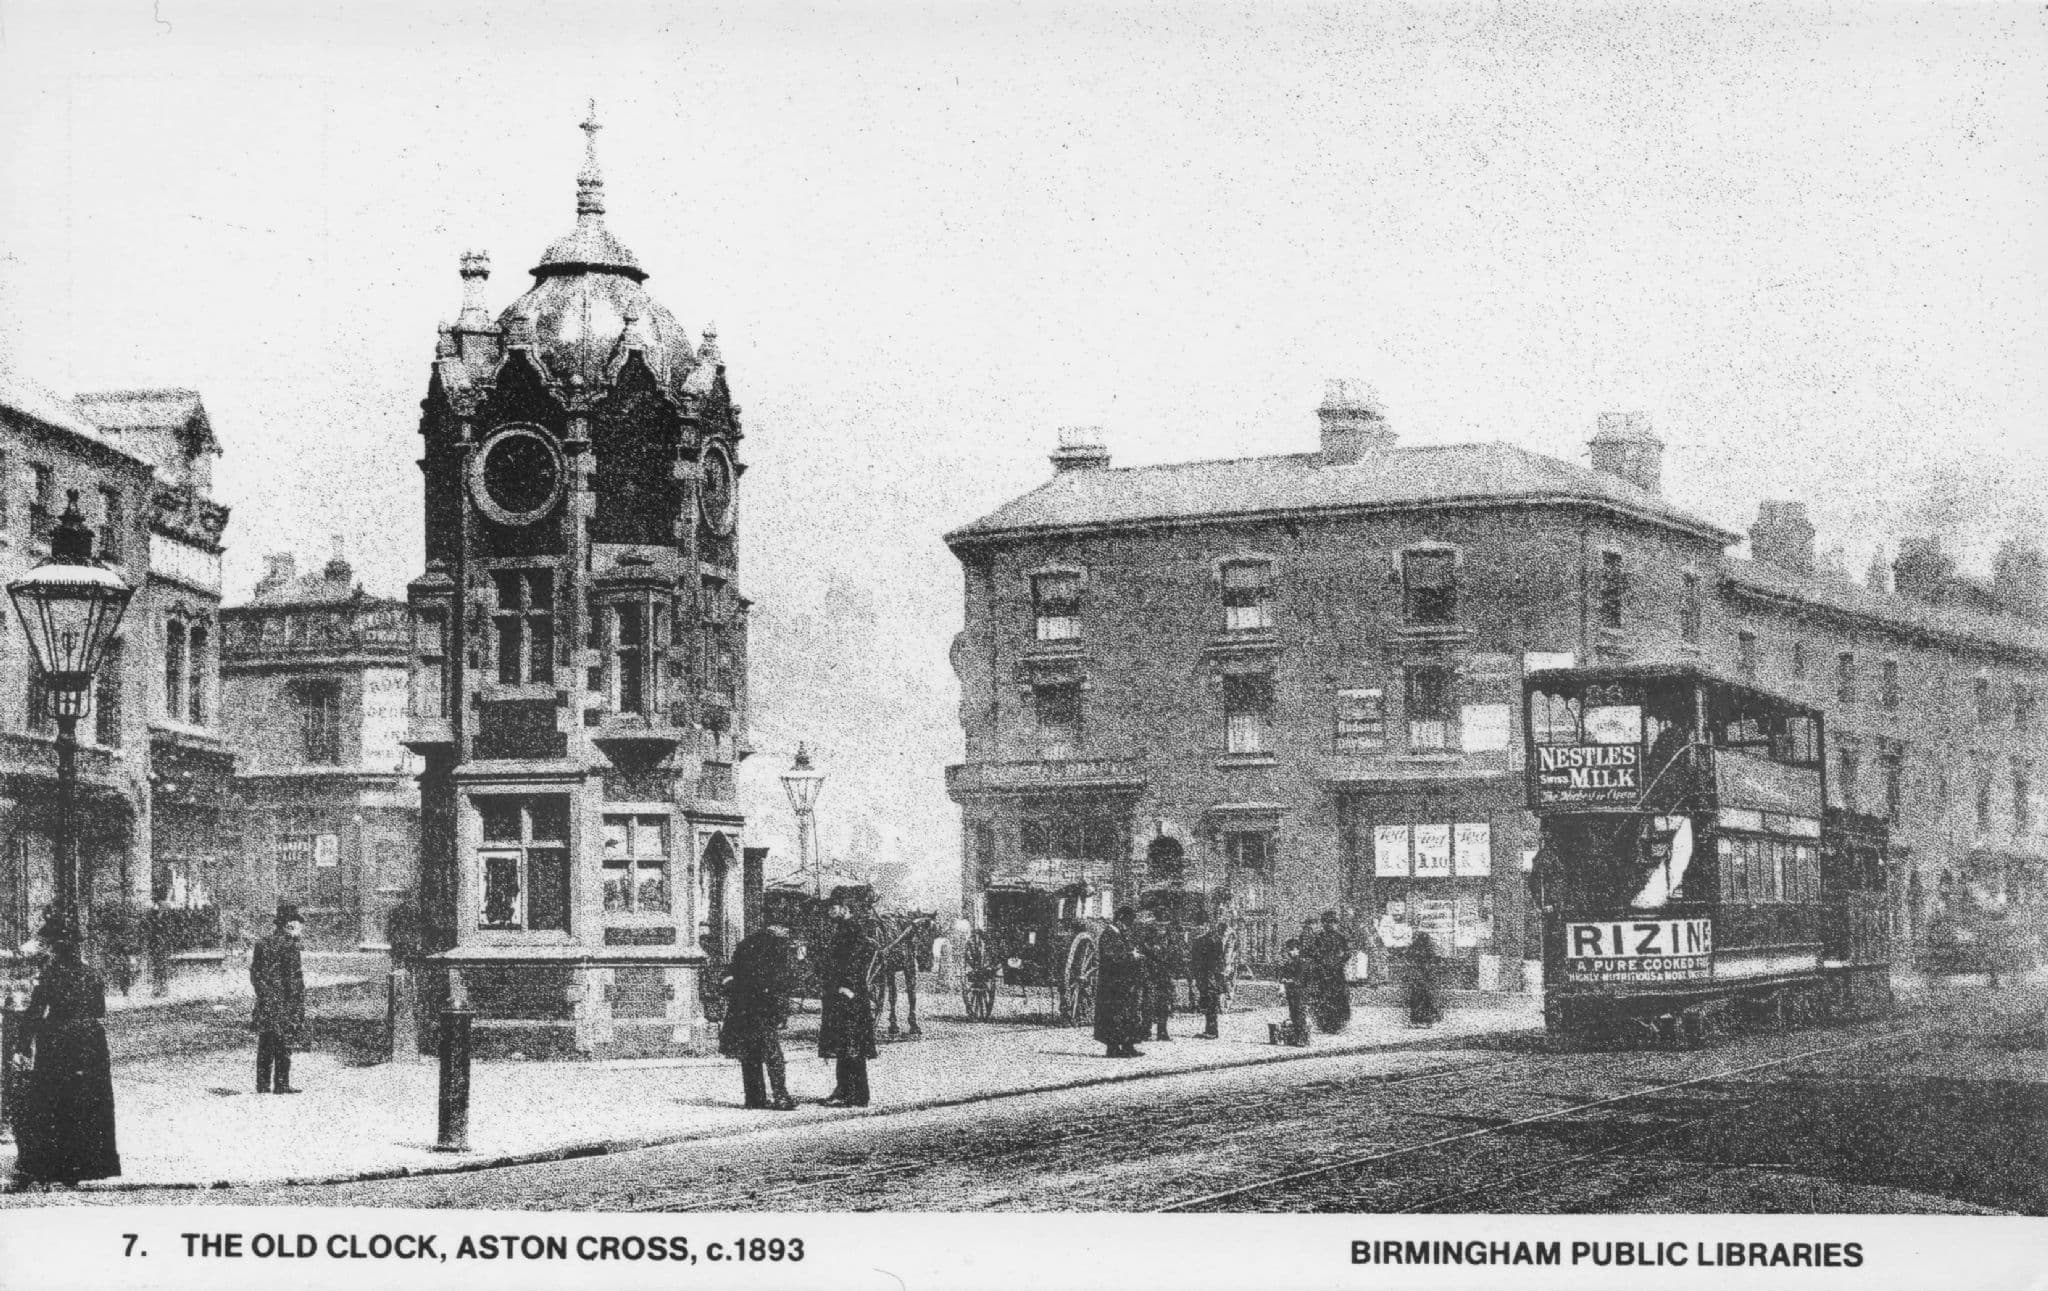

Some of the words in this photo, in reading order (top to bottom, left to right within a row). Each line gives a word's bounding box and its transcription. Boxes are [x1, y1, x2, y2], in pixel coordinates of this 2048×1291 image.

[1568, 767, 1635, 788] MILK
[1573, 921, 1709, 956] RIZINE
[1578, 961, 1587, 971] A
[1594, 960, 1638, 972] PURE
[1643, 958, 1694, 971] COOKED
